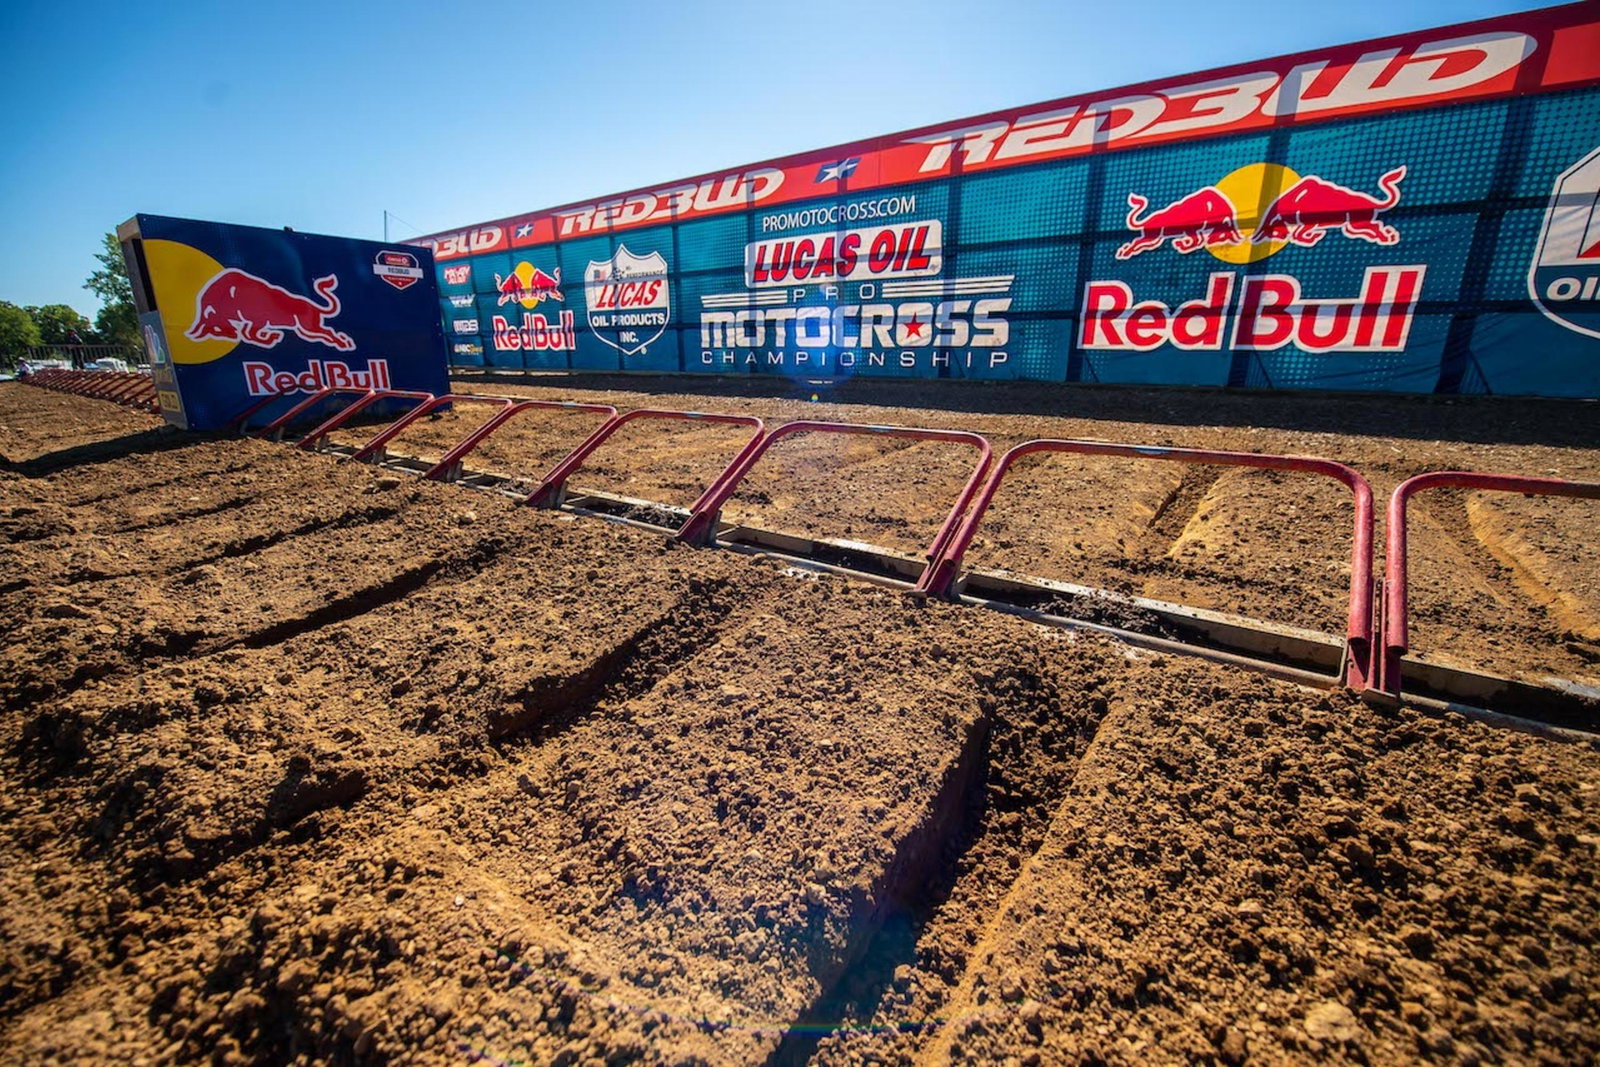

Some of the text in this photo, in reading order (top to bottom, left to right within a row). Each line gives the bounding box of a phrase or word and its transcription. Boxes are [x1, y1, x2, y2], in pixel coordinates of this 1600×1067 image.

[901, 31, 1538, 173] REDBUD
[550, 167, 785, 235] REDBUD
[763, 196, 916, 232] PROMOTOCROSS.COM
[752, 225, 932, 283] LUCAS OIL
[595, 279, 662, 308] LUCAS
[793, 284, 876, 302] PRO
[1076, 264, 1427, 353] Red Bull
[492, 310, 576, 351] Red Bull
[592, 312, 665, 327] OIL PRODUCTS
[620, 331, 640, 343] INC.
[701, 298, 1012, 348] MOTOCROSS
[242, 359, 392, 396] Red Bull
[702, 352, 1008, 368] CHAMPIONSHIP
